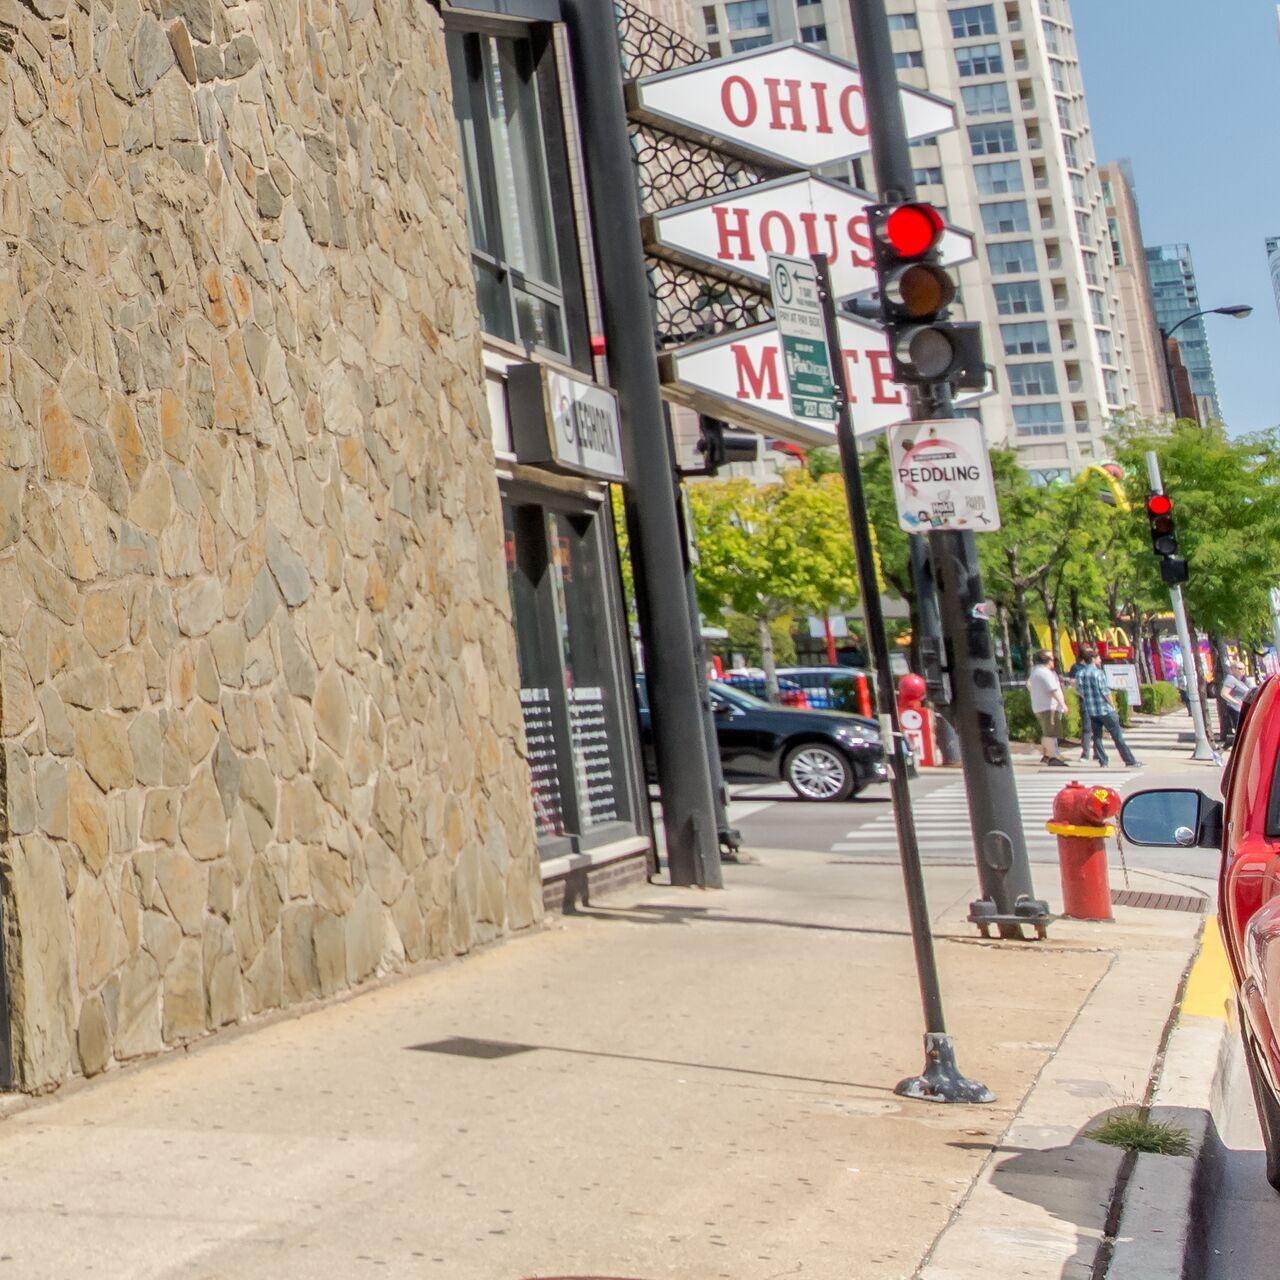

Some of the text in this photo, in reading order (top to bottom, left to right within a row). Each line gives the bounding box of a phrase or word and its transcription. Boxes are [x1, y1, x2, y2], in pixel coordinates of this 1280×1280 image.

[721, 75, 870, 136] OHIO
[712, 205, 876, 268] HOUS
[731, 345, 901, 405] MTE
[898, 466, 980, 483] PEDDLING
